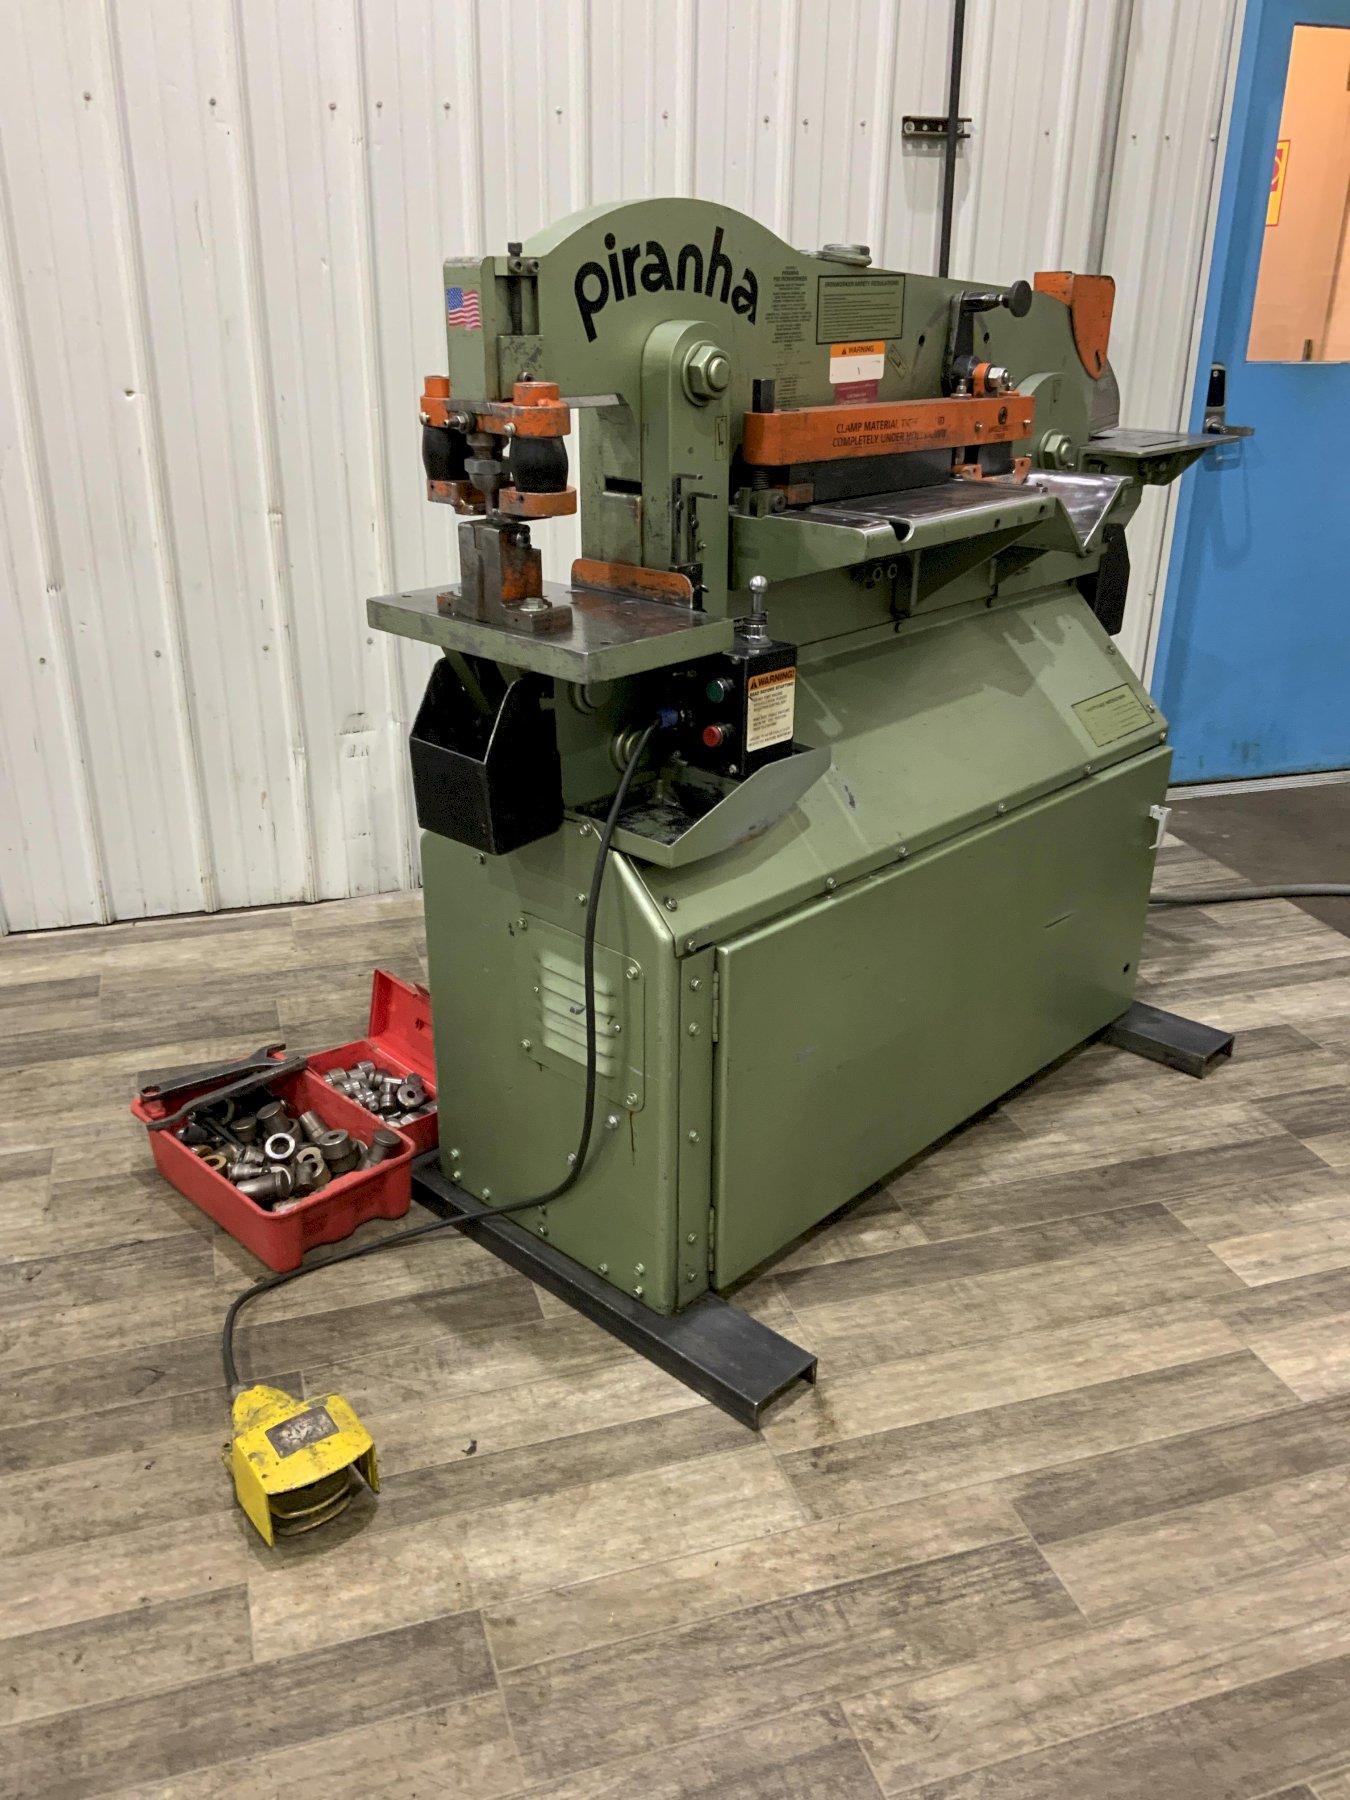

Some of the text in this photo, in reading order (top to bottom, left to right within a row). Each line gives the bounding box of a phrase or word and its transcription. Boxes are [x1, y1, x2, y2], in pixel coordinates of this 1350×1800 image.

[573, 226, 759, 342] piranha
[848, 345, 874, 354] WARNING
[836, 422, 862, 434] CLAMP
[832, 433, 879, 447] COMPLETELY
[881, 432, 906, 444] UNDER
[758, 670, 795, 687] WARNING!
